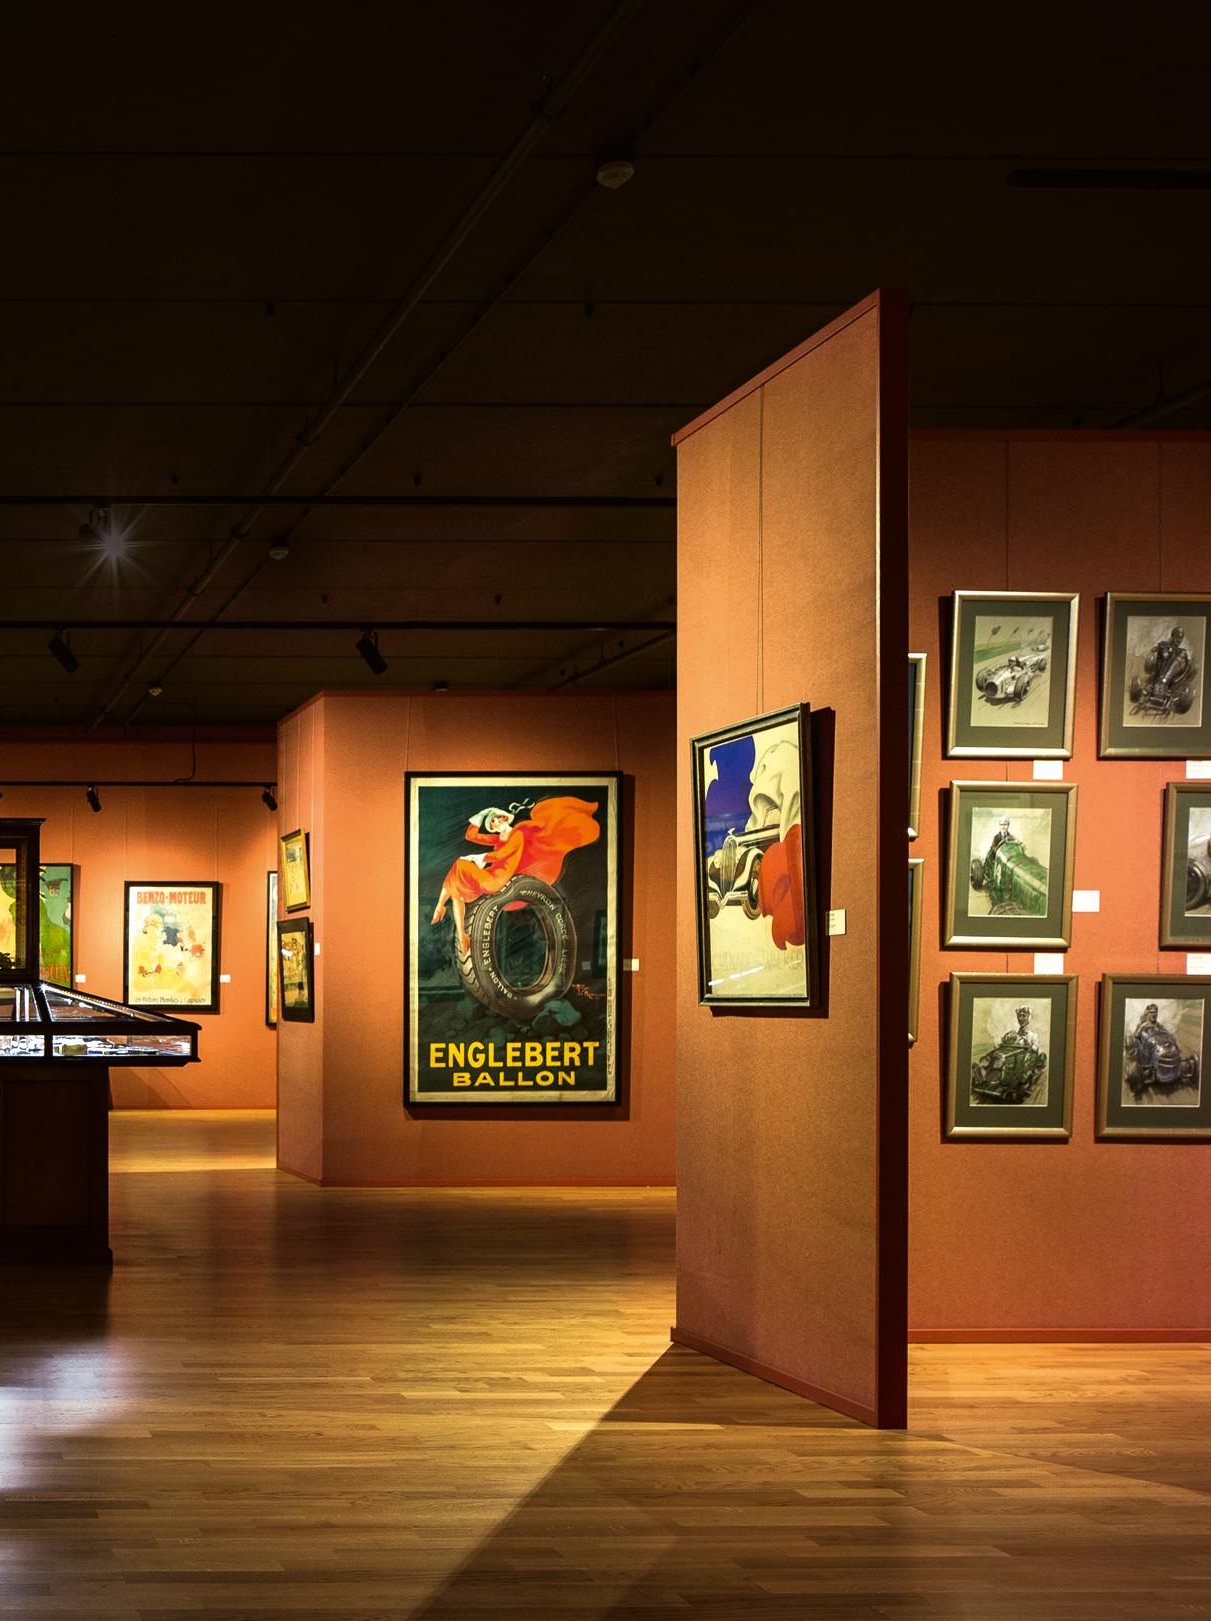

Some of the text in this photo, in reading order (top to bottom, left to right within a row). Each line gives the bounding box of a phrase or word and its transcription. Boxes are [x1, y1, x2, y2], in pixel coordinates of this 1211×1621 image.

[482, 905, 499, 965] ENGLEBERT
[429, 1041, 600, 1069] ENGLEBERT
[452, 1070, 576, 1087] BALLON
